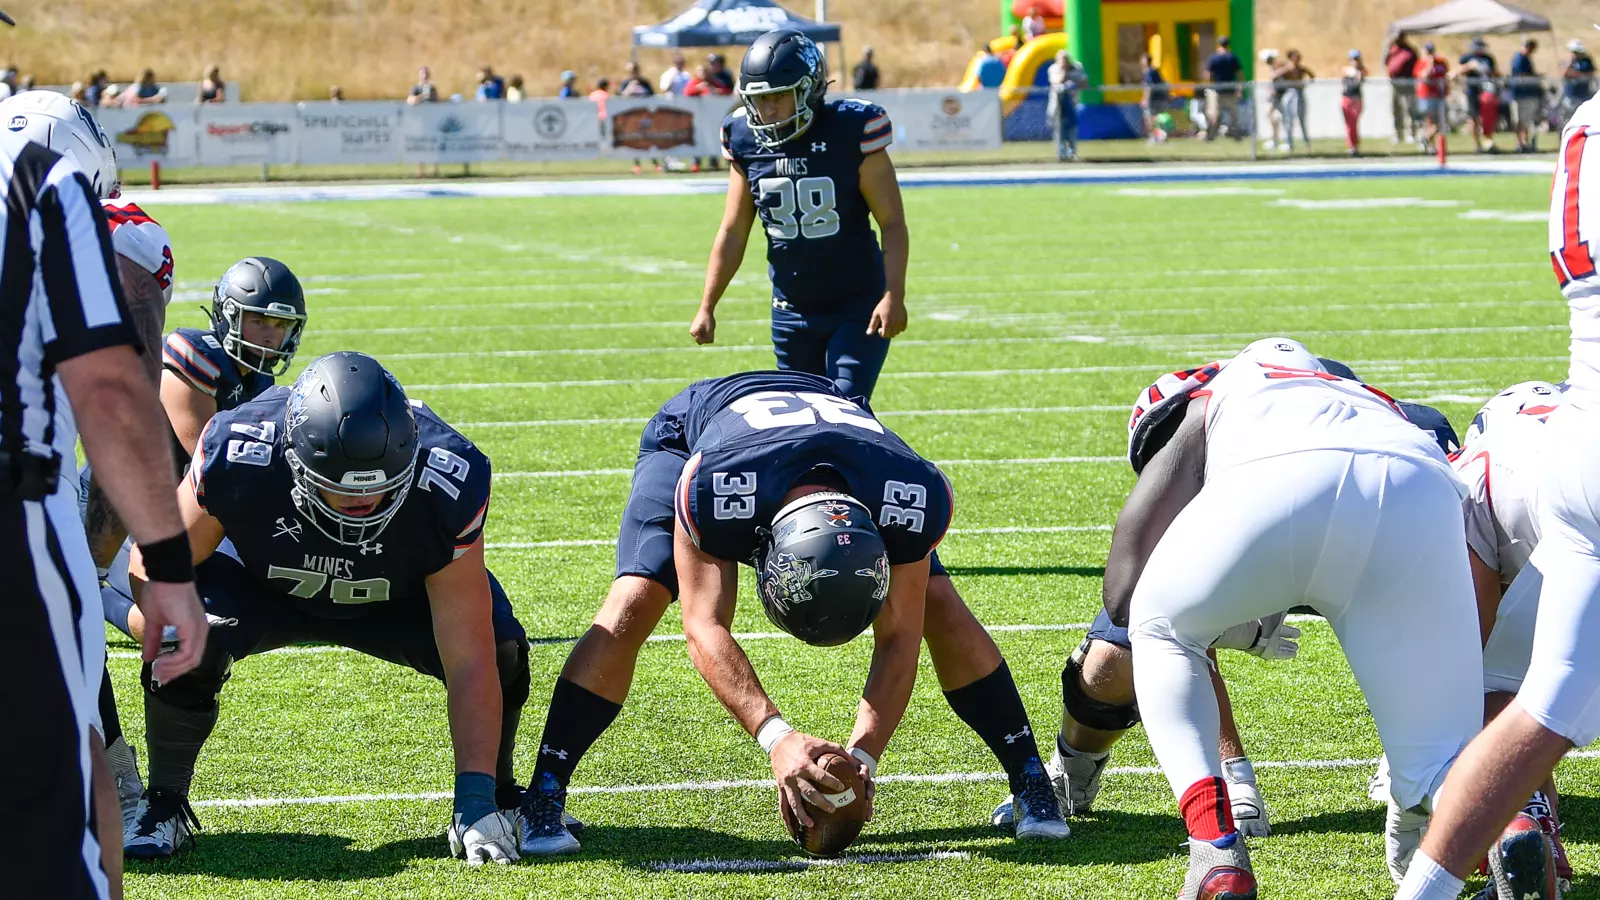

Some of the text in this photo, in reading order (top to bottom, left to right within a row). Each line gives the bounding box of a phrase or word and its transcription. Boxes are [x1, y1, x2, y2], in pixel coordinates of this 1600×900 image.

[775, 157, 808, 175] MINES
[758, 176, 840, 239] 38
[226, 421, 277, 467] 79
[353, 474, 377, 482] MINES
[417, 447, 471, 501] 79
[712, 471, 758, 520] 33
[878, 480, 927, 534] 33
[835, 533, 852, 546] 33
[302, 553, 355, 580] MINES
